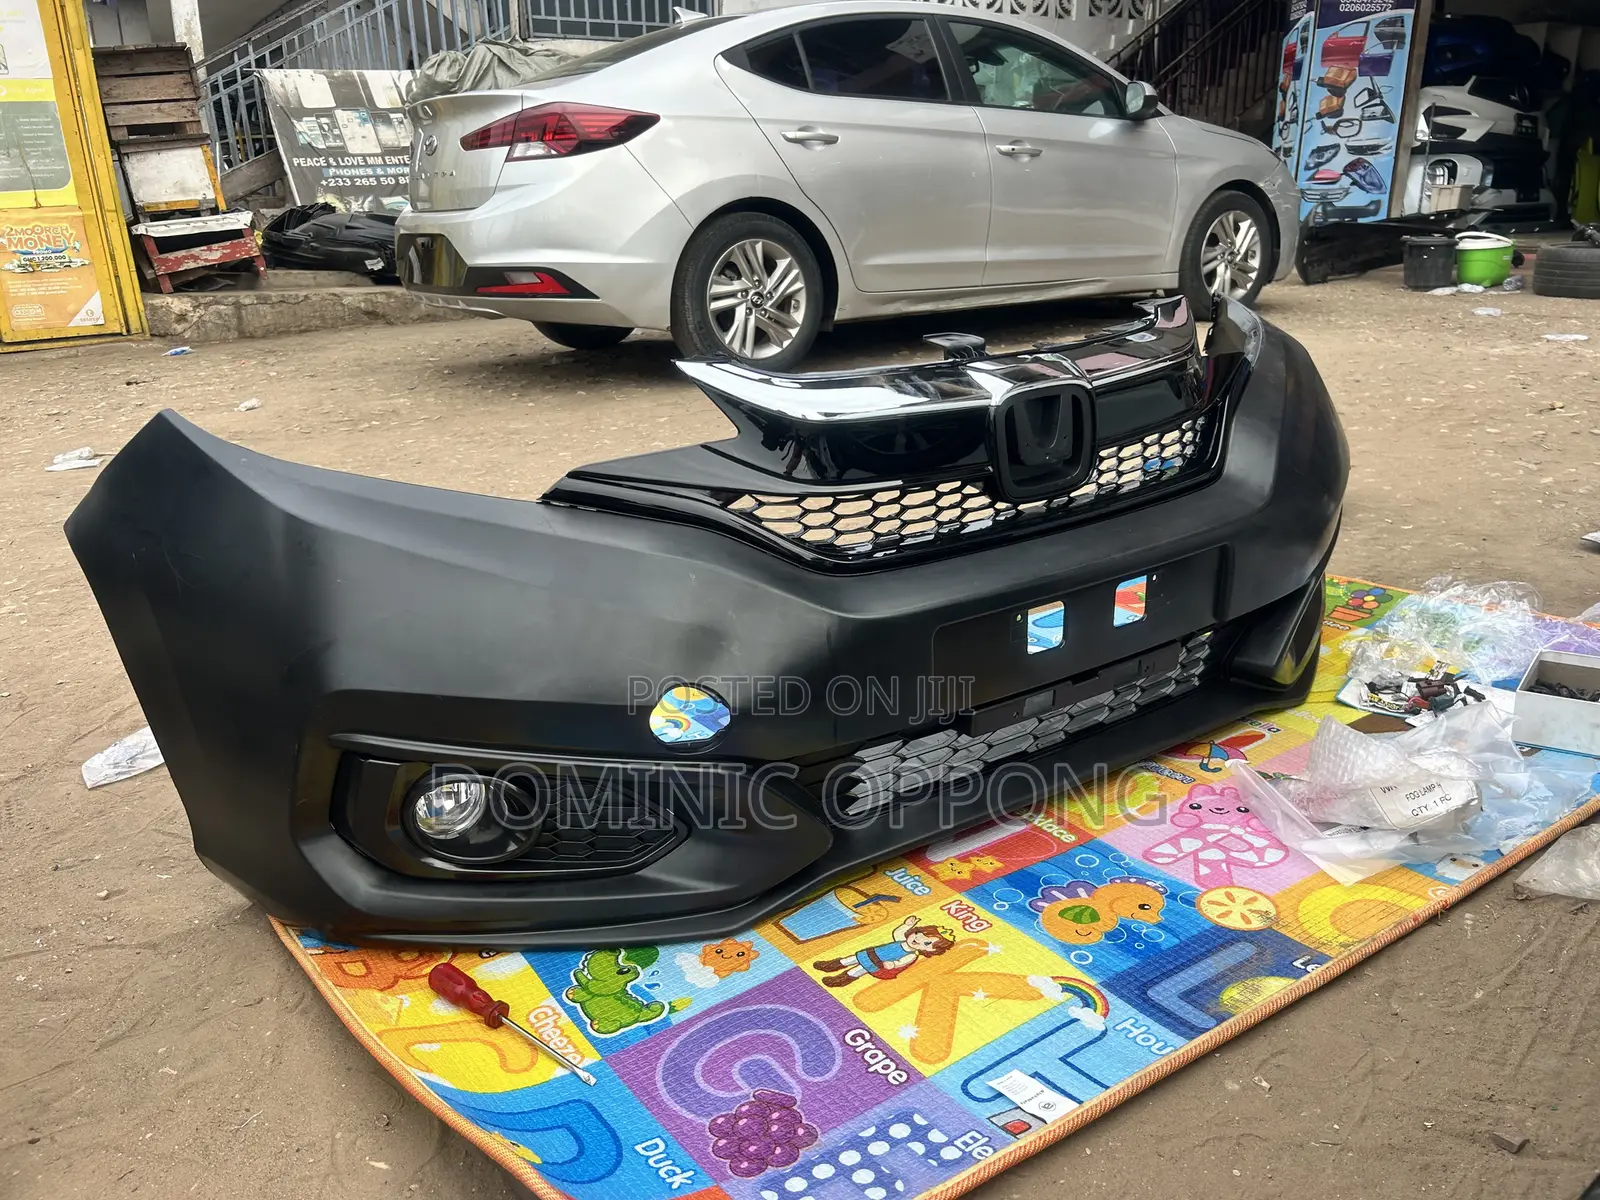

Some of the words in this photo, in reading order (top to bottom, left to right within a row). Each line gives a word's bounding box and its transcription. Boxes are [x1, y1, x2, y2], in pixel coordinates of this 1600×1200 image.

[1339, 3, 1392, 12] 0206025572
[293, 157, 327, 167] PEACE
[329, 157, 337, 166] &
[338, 156, 365, 166] LOVE
[367, 155, 384, 165] MM
[329, 167, 374, 176] PHONES
[375, 167, 384, 175] &
[320, 177, 351, 187] +233
[354, 177, 377, 186] 265
[380, 177, 395, 185] 50
[7, 232, 75, 250] MONEY
[1405, 789, 1420, 802] FOG
[1421, 783, 1437, 797] LAMP
[884, 867, 931, 897] Juice
[941, 900, 992, 933] King
[844, 1027, 908, 1086] Grape
[634, 1137, 696, 1189] Duck
